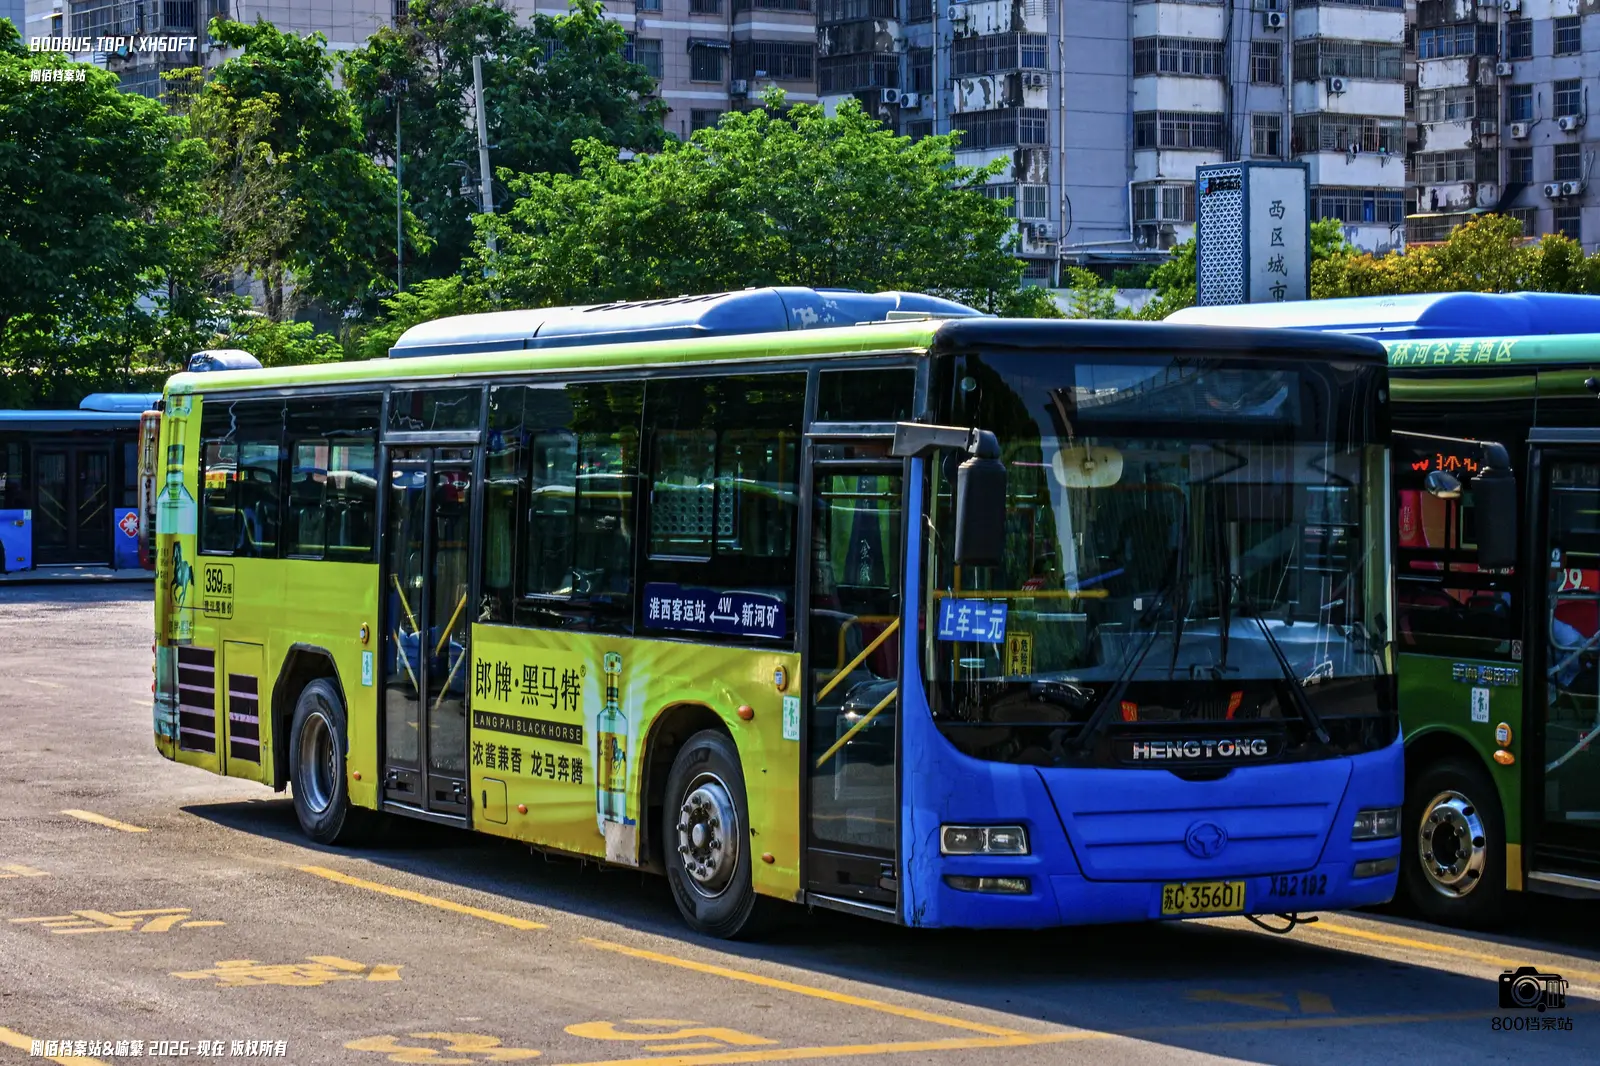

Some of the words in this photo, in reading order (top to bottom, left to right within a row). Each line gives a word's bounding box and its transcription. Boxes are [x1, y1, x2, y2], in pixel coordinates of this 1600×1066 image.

[1267, 200, 1288, 302] 西区城市
[1384, 339, 1519, 365] 林河谷美酒区
[649, 596, 707, 624] 淮西客运站
[717, 597, 732, 614] 4W
[741, 601, 779, 629] 新河矿
[940, 604, 1003, 640] 上车二元
[475, 657, 581, 712] 郎牌·黑马特
[474, 714, 498, 728] LANG
[500, 718, 515, 732] PAI
[516, 721, 546, 736] BLACK
[548, 727, 581, 741] HORSE
[472, 741, 522, 774] 浓酱兼香
[531, 750, 583, 785] 龙马奔腾
[1132, 739, 1268, 760] HENGTONG
